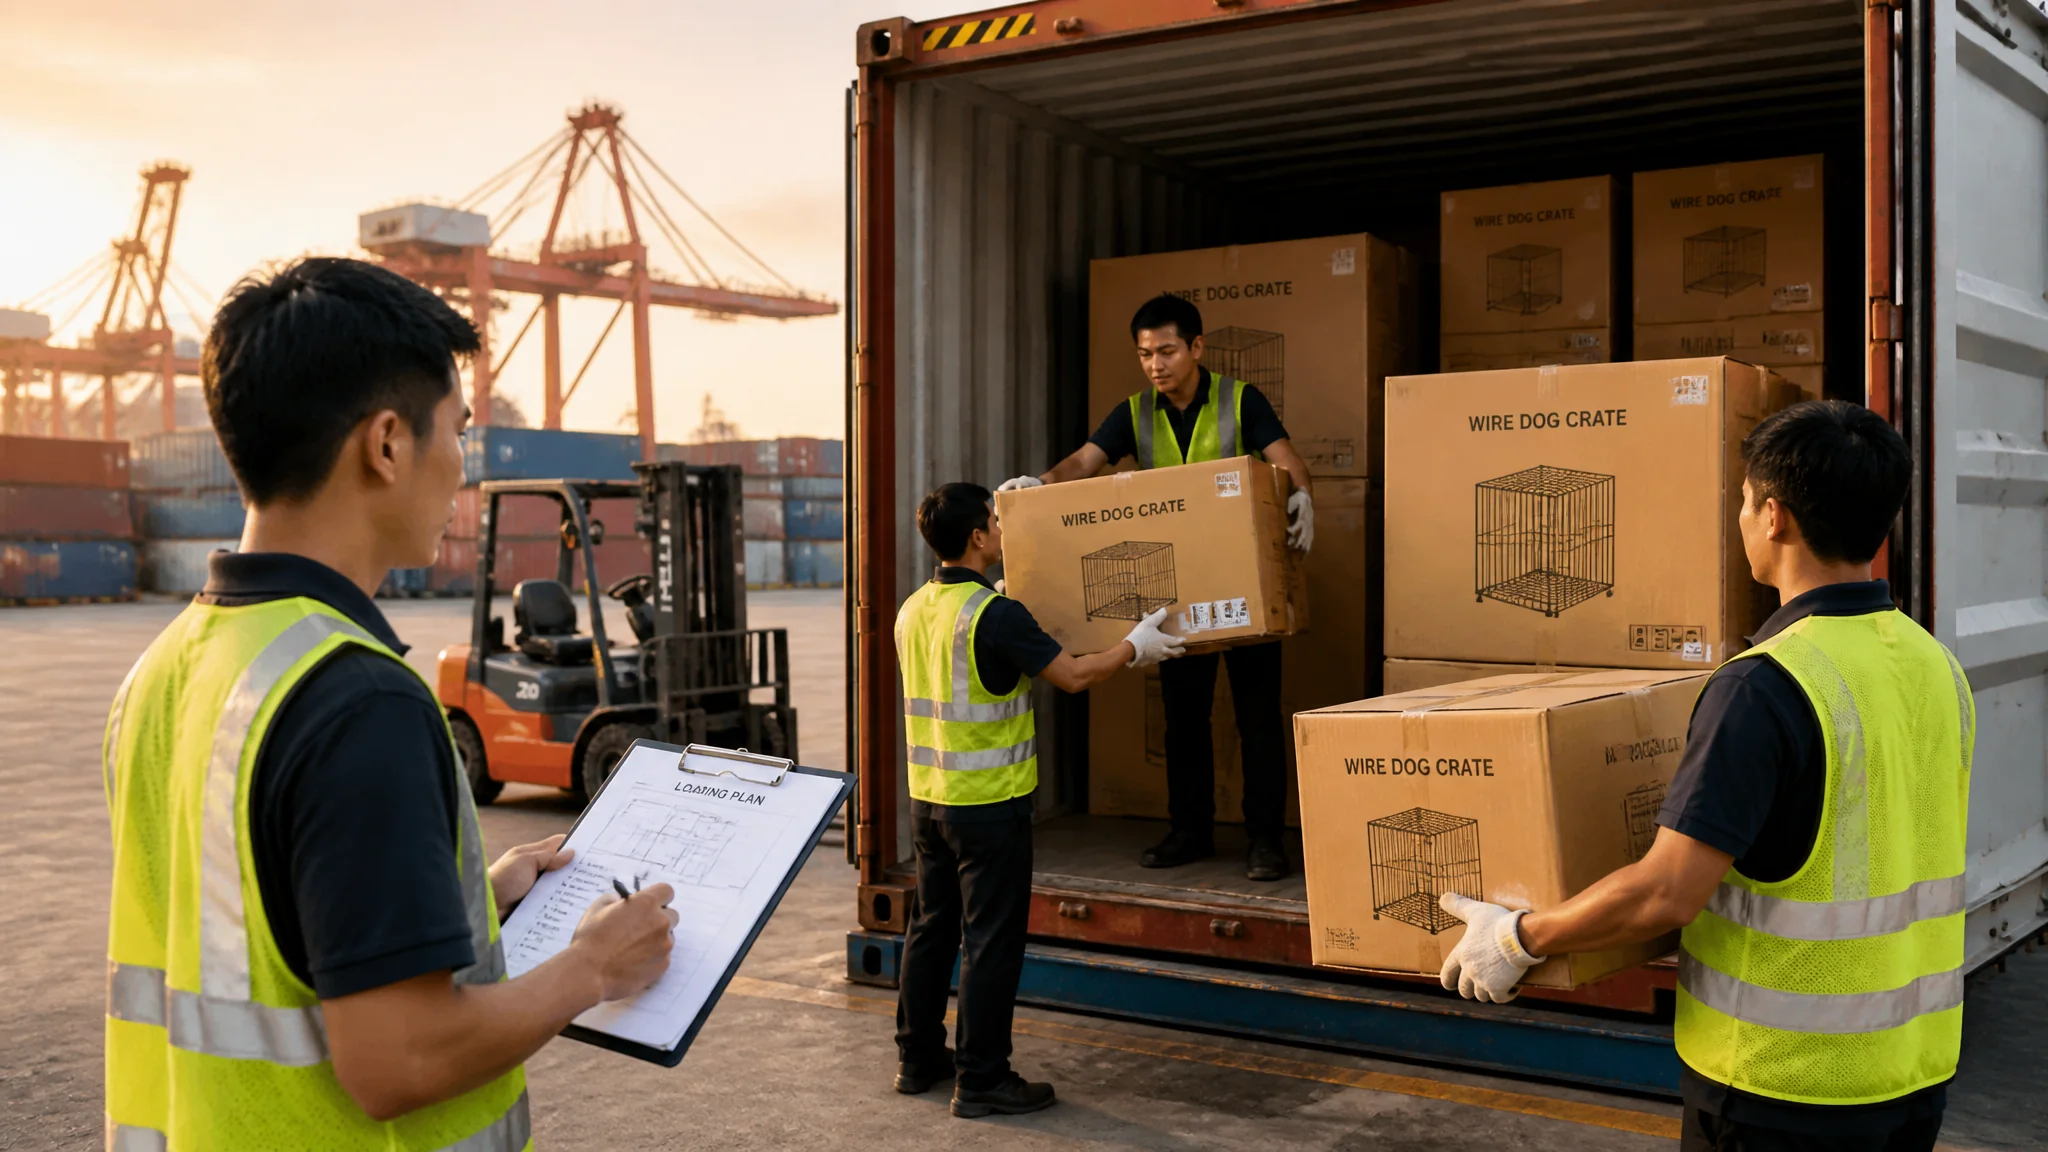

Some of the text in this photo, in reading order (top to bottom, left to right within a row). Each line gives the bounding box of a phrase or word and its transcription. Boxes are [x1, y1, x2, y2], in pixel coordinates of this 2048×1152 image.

[1669, 195, 1703, 210] WIRE
[1706, 192, 1736, 207] DOG
[1473, 207, 1576, 228] WIRE DOG CRATE
[1206, 285, 1239, 301] DOG
[1243, 281, 1293, 298] CRATE
[1469, 408, 1628, 431] WIRE DOG CRATE
[1061, 498, 1186, 527] WIRE DOG CRATE
[515, 681, 540, 700] 20
[1344, 757, 1495, 777] WIRE DOG CRATE
[729, 790, 766, 807] PLAN
